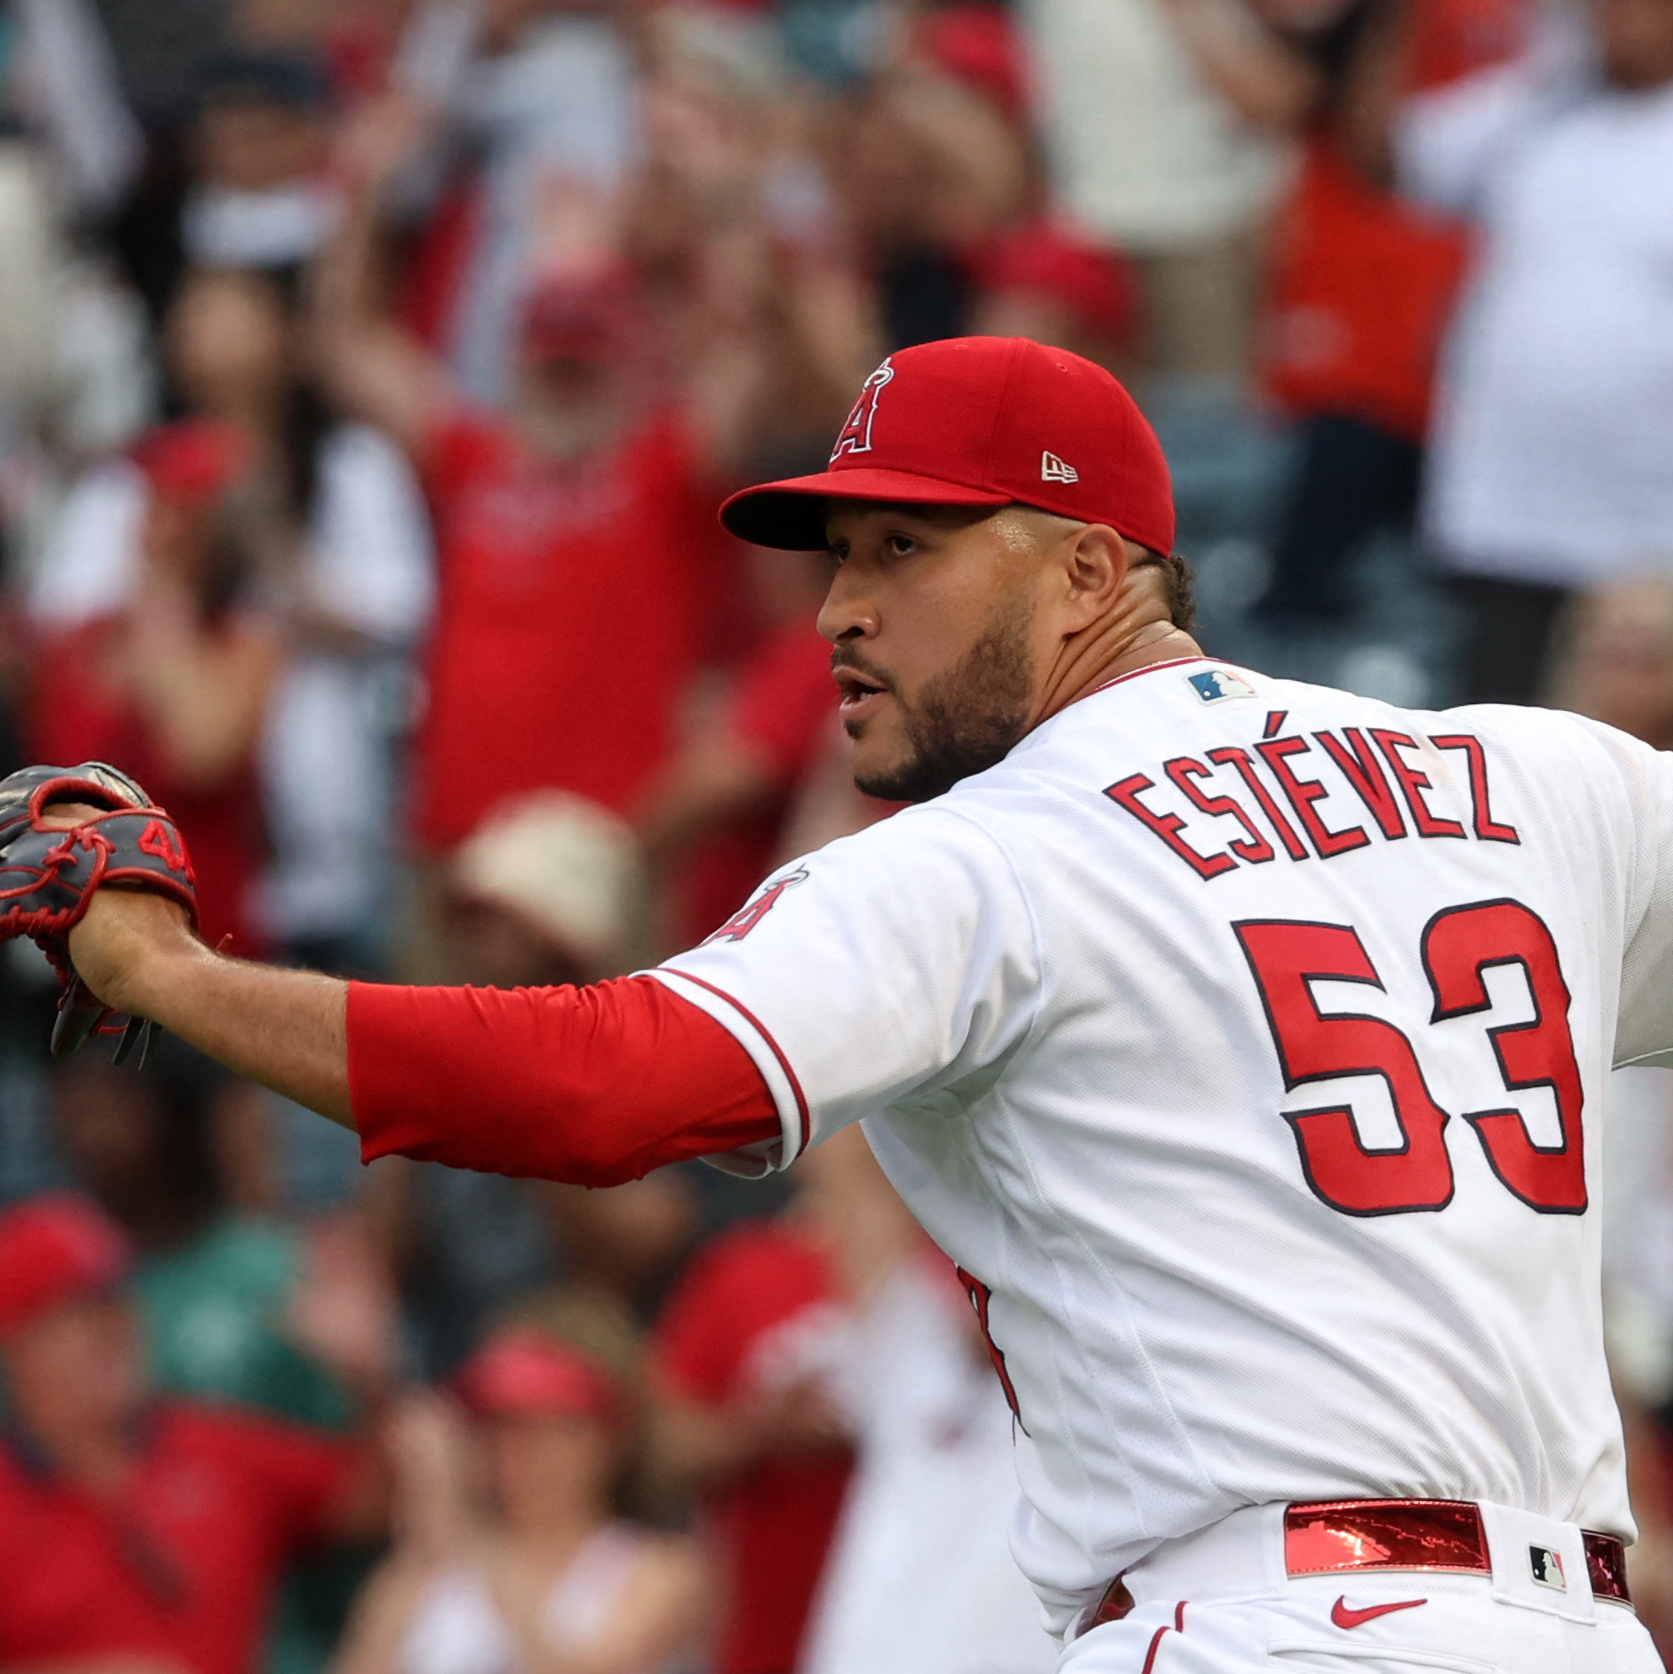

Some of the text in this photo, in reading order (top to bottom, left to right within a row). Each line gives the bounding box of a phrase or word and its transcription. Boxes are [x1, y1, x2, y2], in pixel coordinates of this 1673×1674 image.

[828, 356, 894, 463] A
[1101, 710, 1522, 882] ESTÉVEZ
[1229, 897, 1588, 1218] 53
